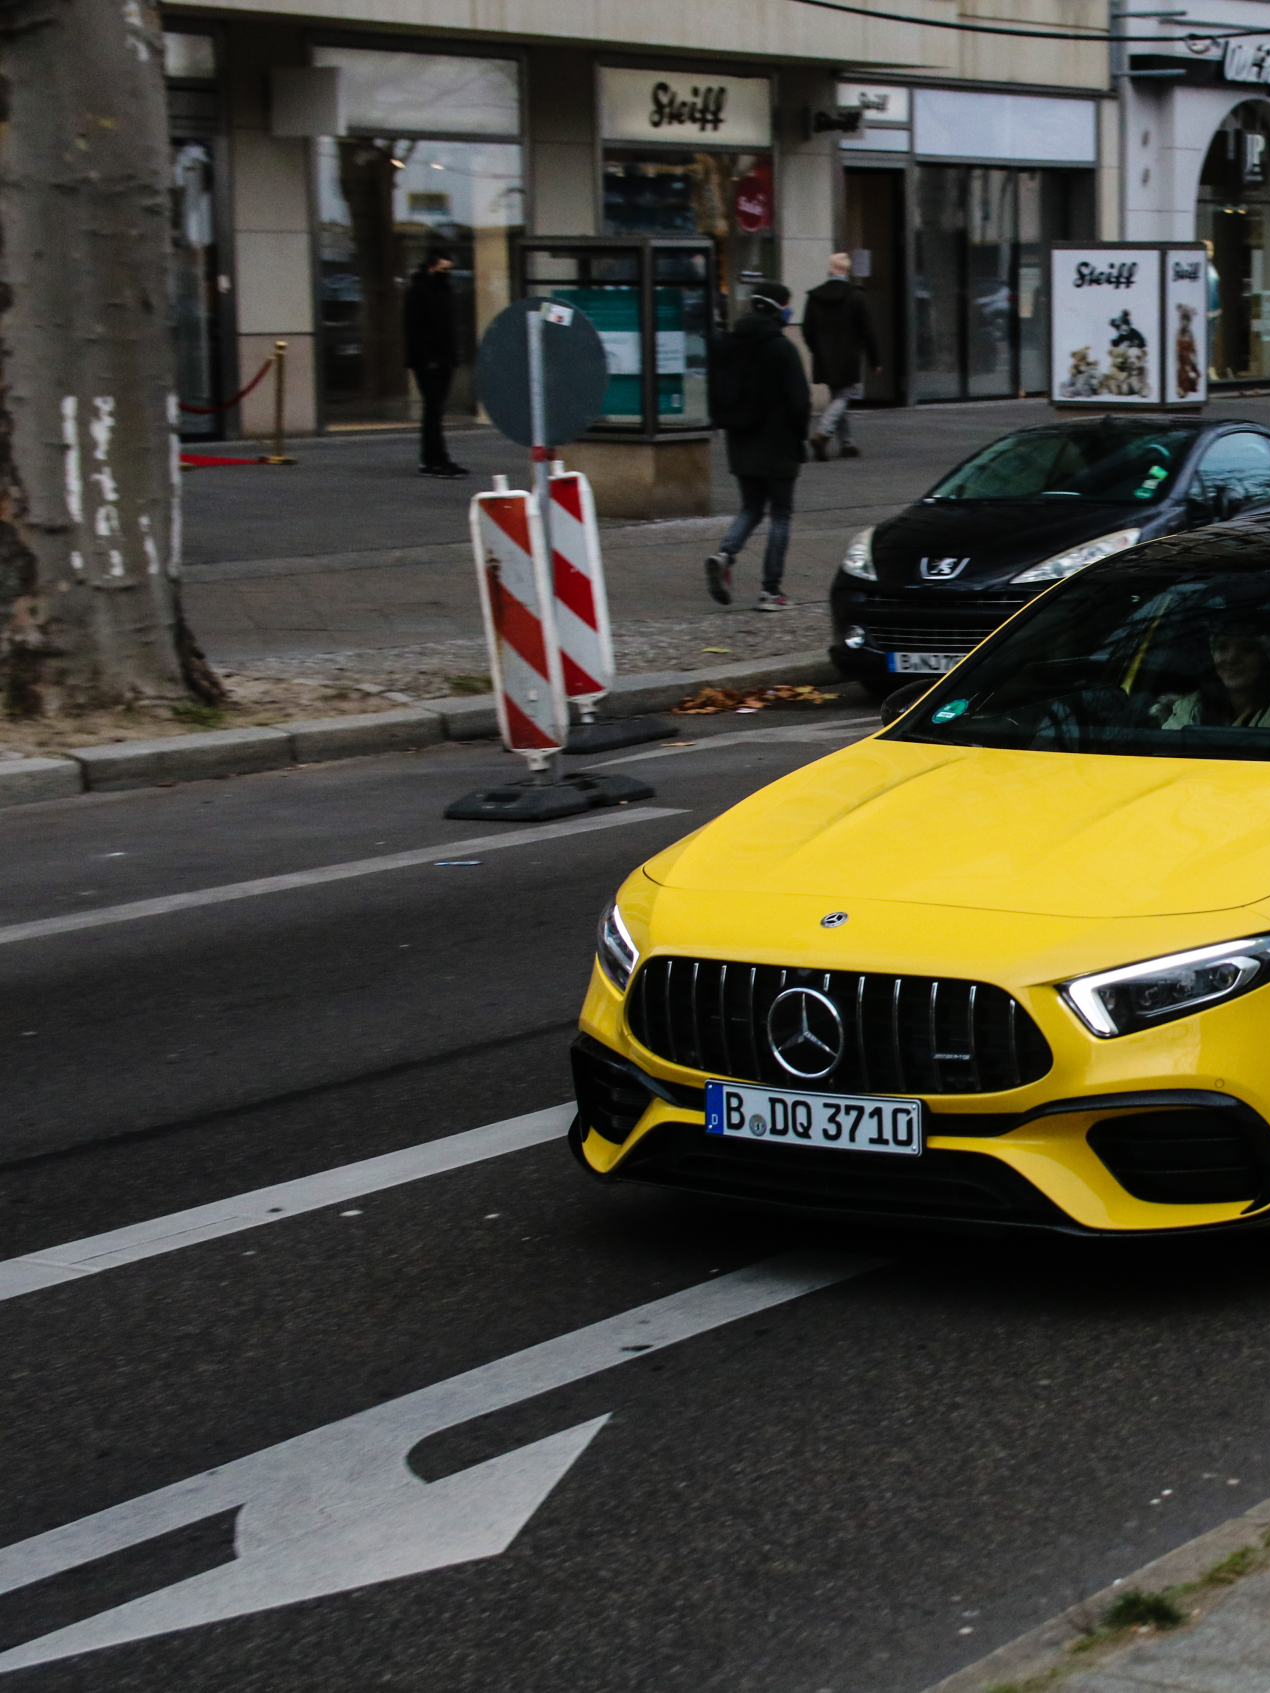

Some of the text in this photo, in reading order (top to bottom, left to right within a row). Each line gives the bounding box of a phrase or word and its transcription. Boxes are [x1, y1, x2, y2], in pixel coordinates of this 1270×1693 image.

[649, 81, 727, 132] Steiff
[1073, 261, 1138, 290] Steiff
[901, 654, 911, 671] B
[711, 1114, 719, 1125] D
[725, 1091, 915, 1147] B DQ 3710
